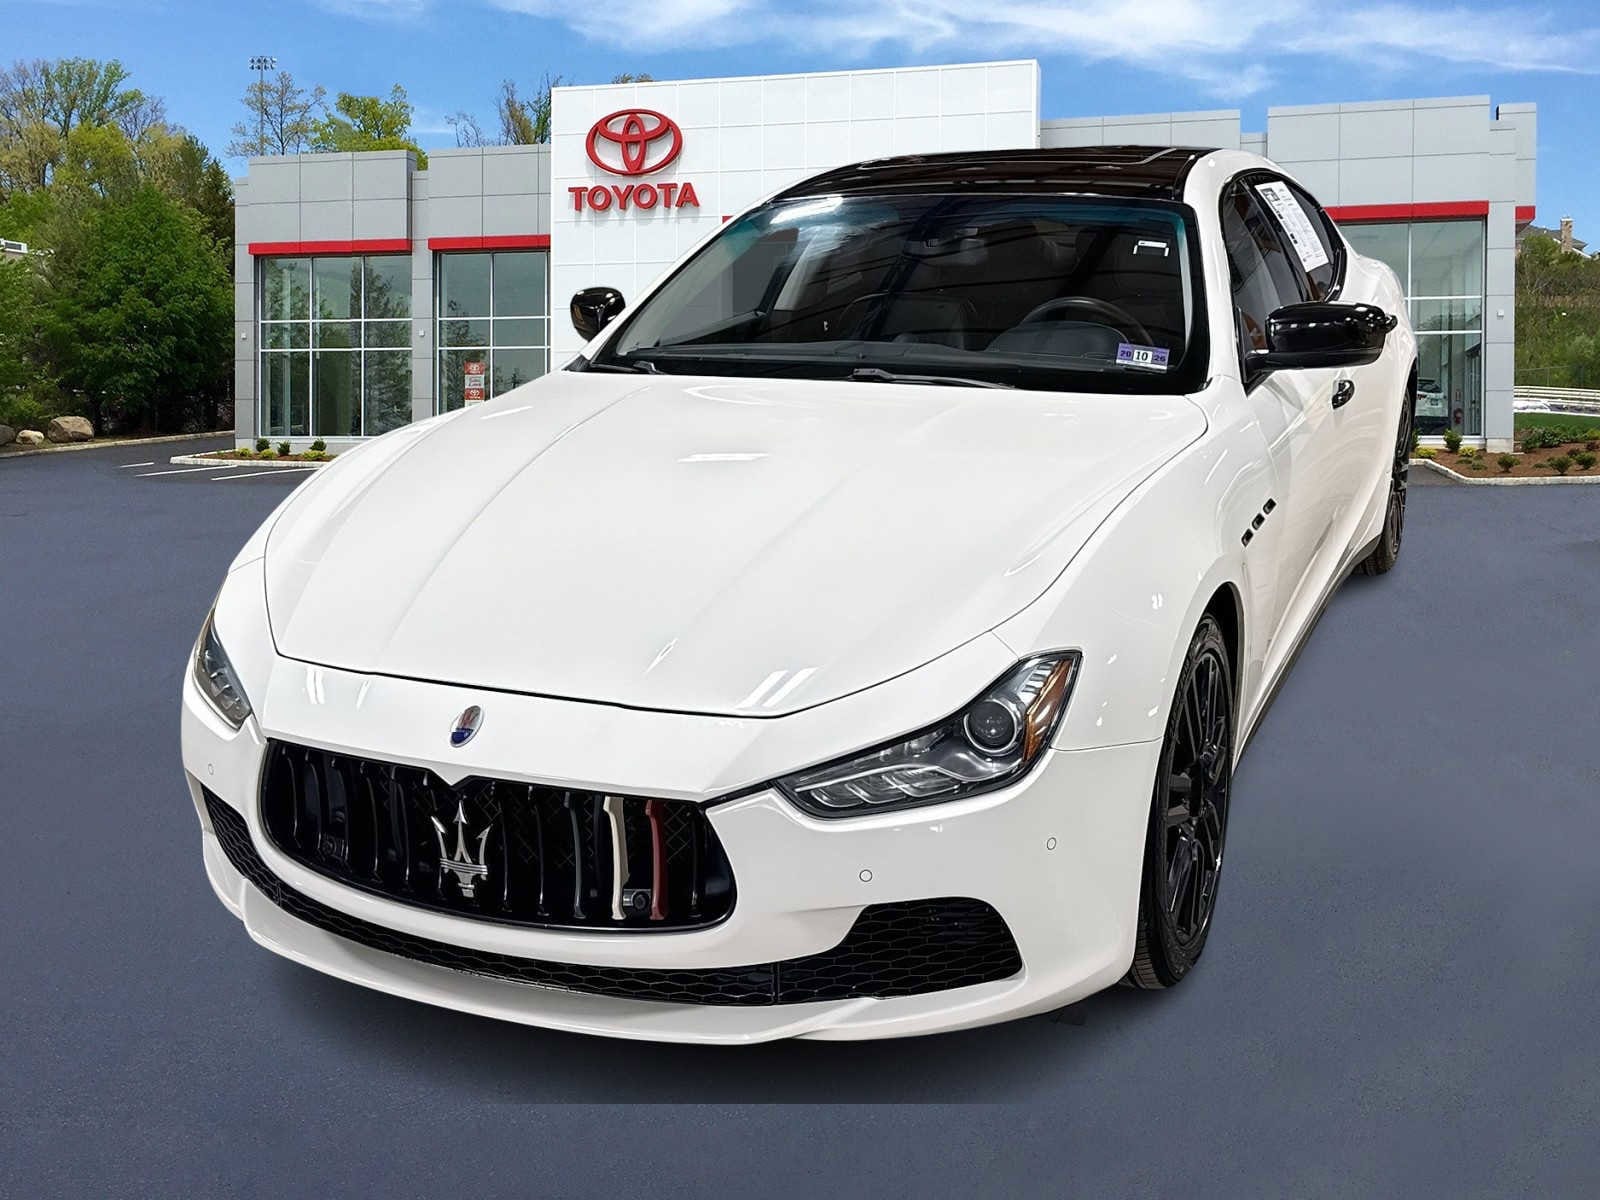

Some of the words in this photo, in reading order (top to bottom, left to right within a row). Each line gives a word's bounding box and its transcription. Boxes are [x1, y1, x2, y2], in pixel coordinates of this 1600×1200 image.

[568, 182, 700, 211] TOYOTA
[1120, 350, 1132, 358] 20
[1136, 351, 1149, 361] 10
